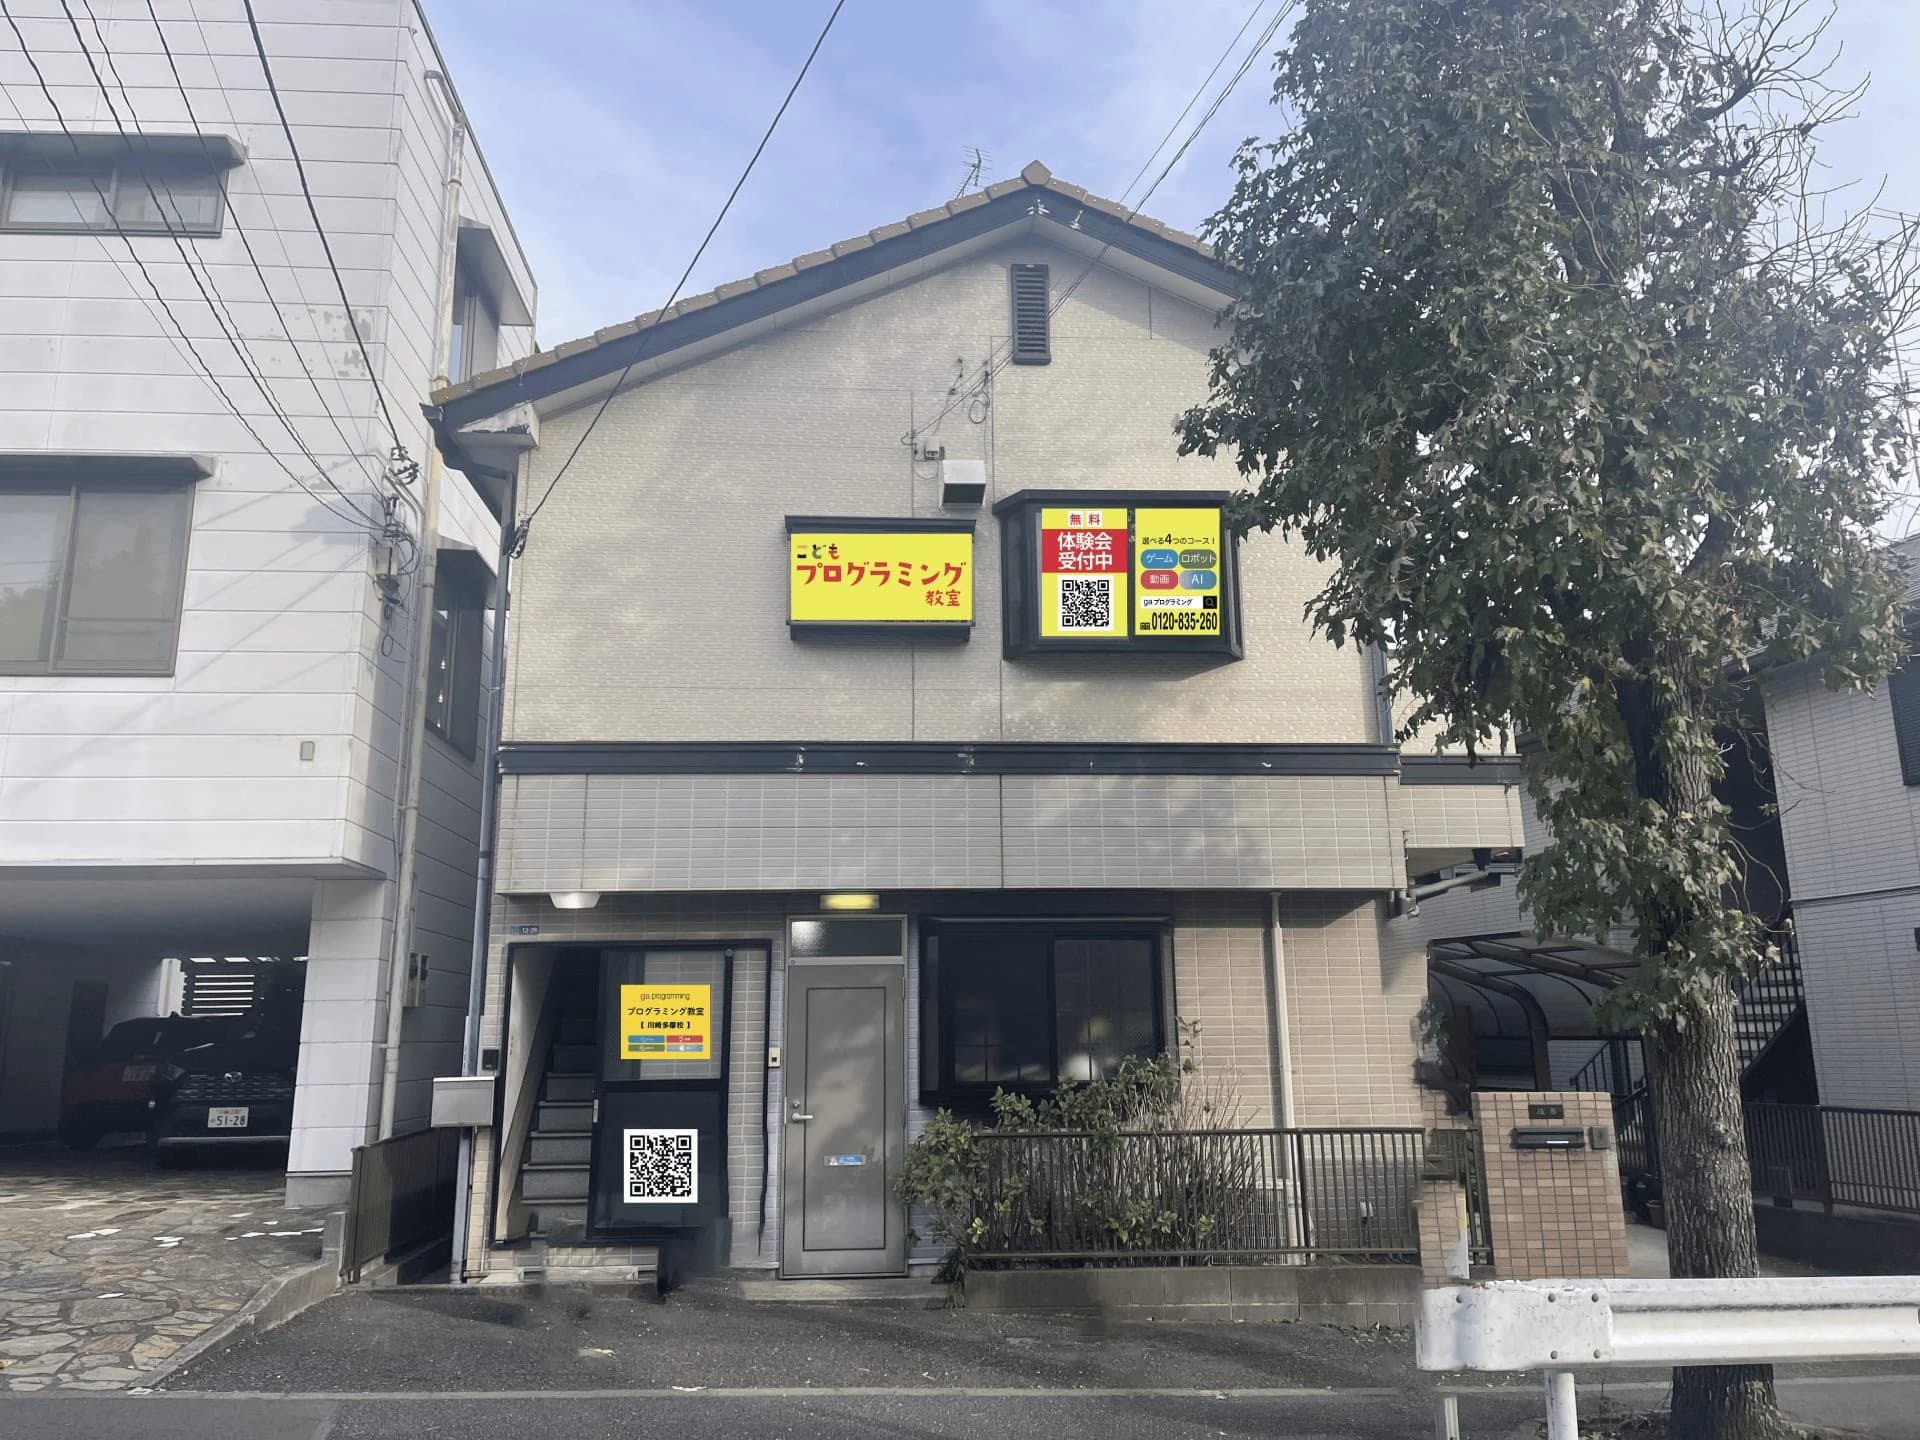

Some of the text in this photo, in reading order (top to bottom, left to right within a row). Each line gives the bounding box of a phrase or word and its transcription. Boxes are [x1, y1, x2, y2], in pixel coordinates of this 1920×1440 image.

[1069, 513, 1101, 526] 無料
[1057, 532, 1112, 551] 体験会
[796, 543, 840, 560] こども
[1058, 551, 1112, 571] 受付中
[1145, 553, 1173, 563] ゲーム
[1181, 553, 1216, 564] ロボット
[796, 561, 967, 588] プログラミング
[1149, 574, 1170, 585] 動画
[1191, 574, 1204, 585] AI
[925, 588, 961, 607] 教室
[1153, 598, 1194, 606] プログラミング
[1151, 611, 1218, 631] 0120-835-260
[627, 1007, 704, 1016] プログラミング教室
[216, 1115, 246, 1126] 51-28
